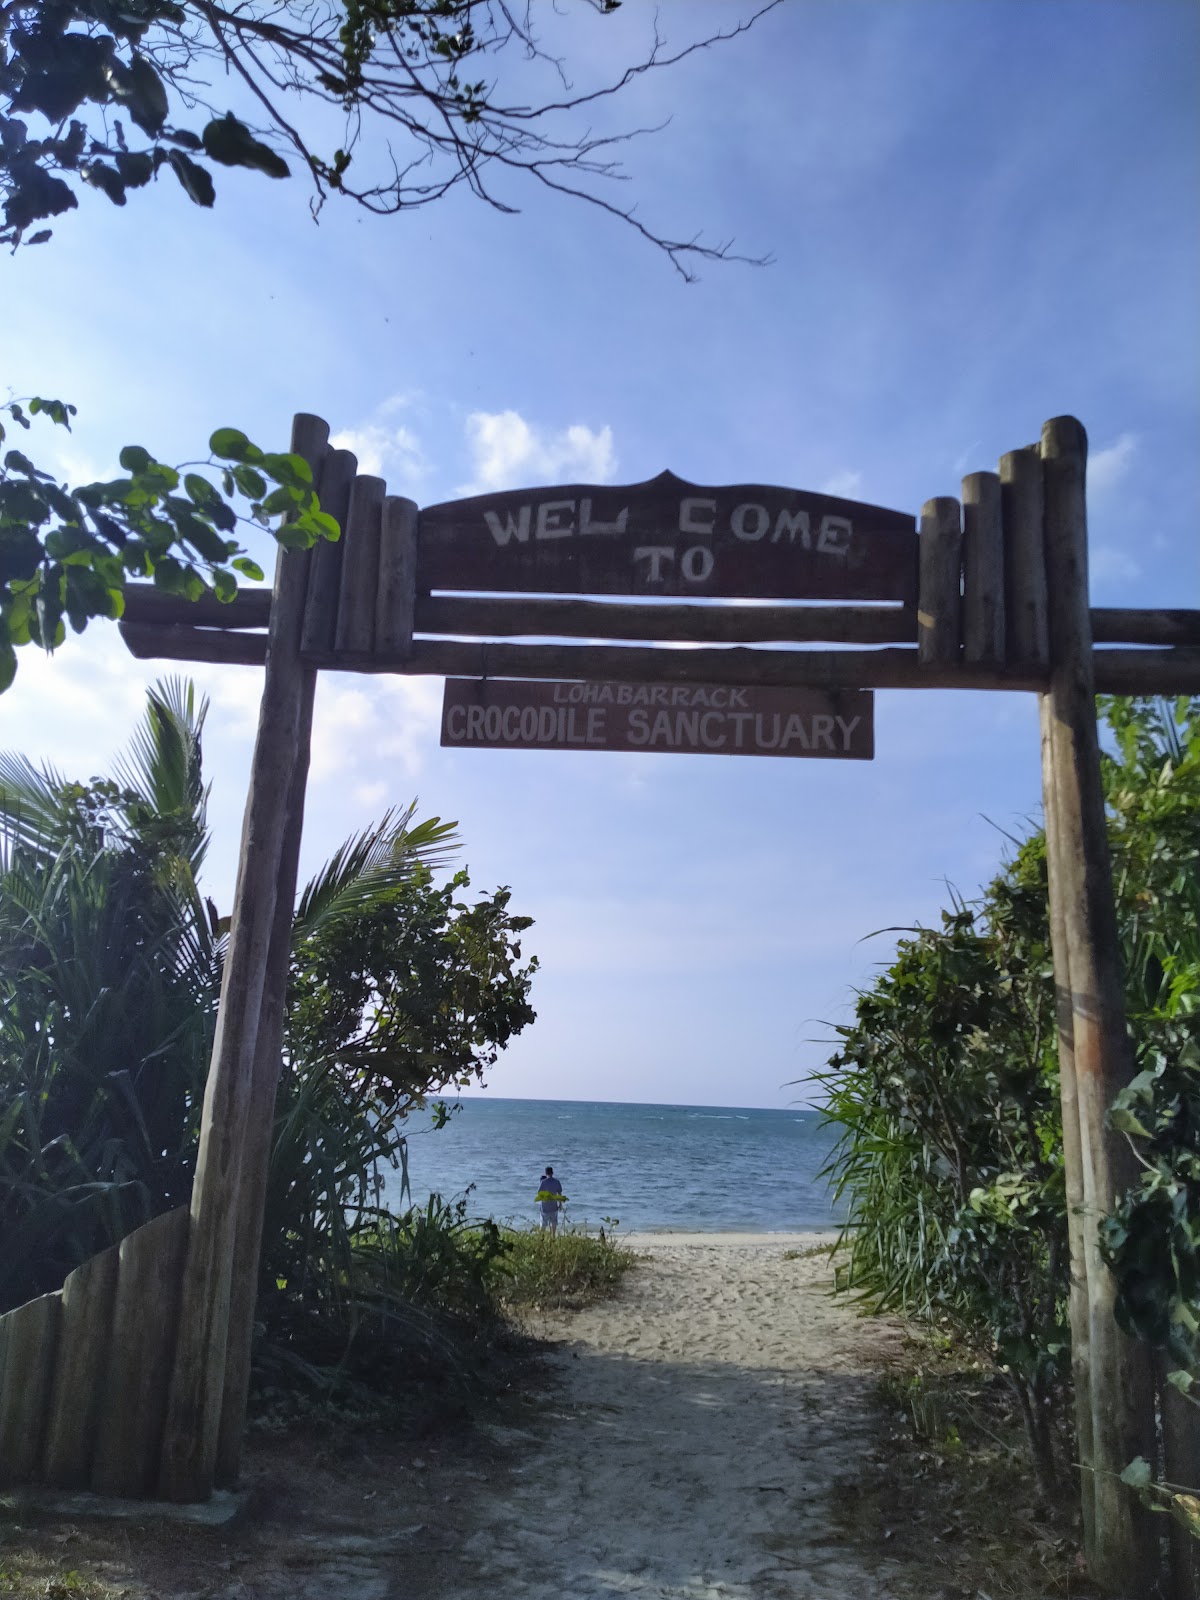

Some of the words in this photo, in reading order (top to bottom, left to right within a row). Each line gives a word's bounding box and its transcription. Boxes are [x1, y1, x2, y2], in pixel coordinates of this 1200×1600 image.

[633, 546, 715, 582] TO
[553, 683, 750, 708] LOHABARRACK
[446, 704, 607, 744] CROCODILE
[627, 709, 862, 751] SANCTUARY
